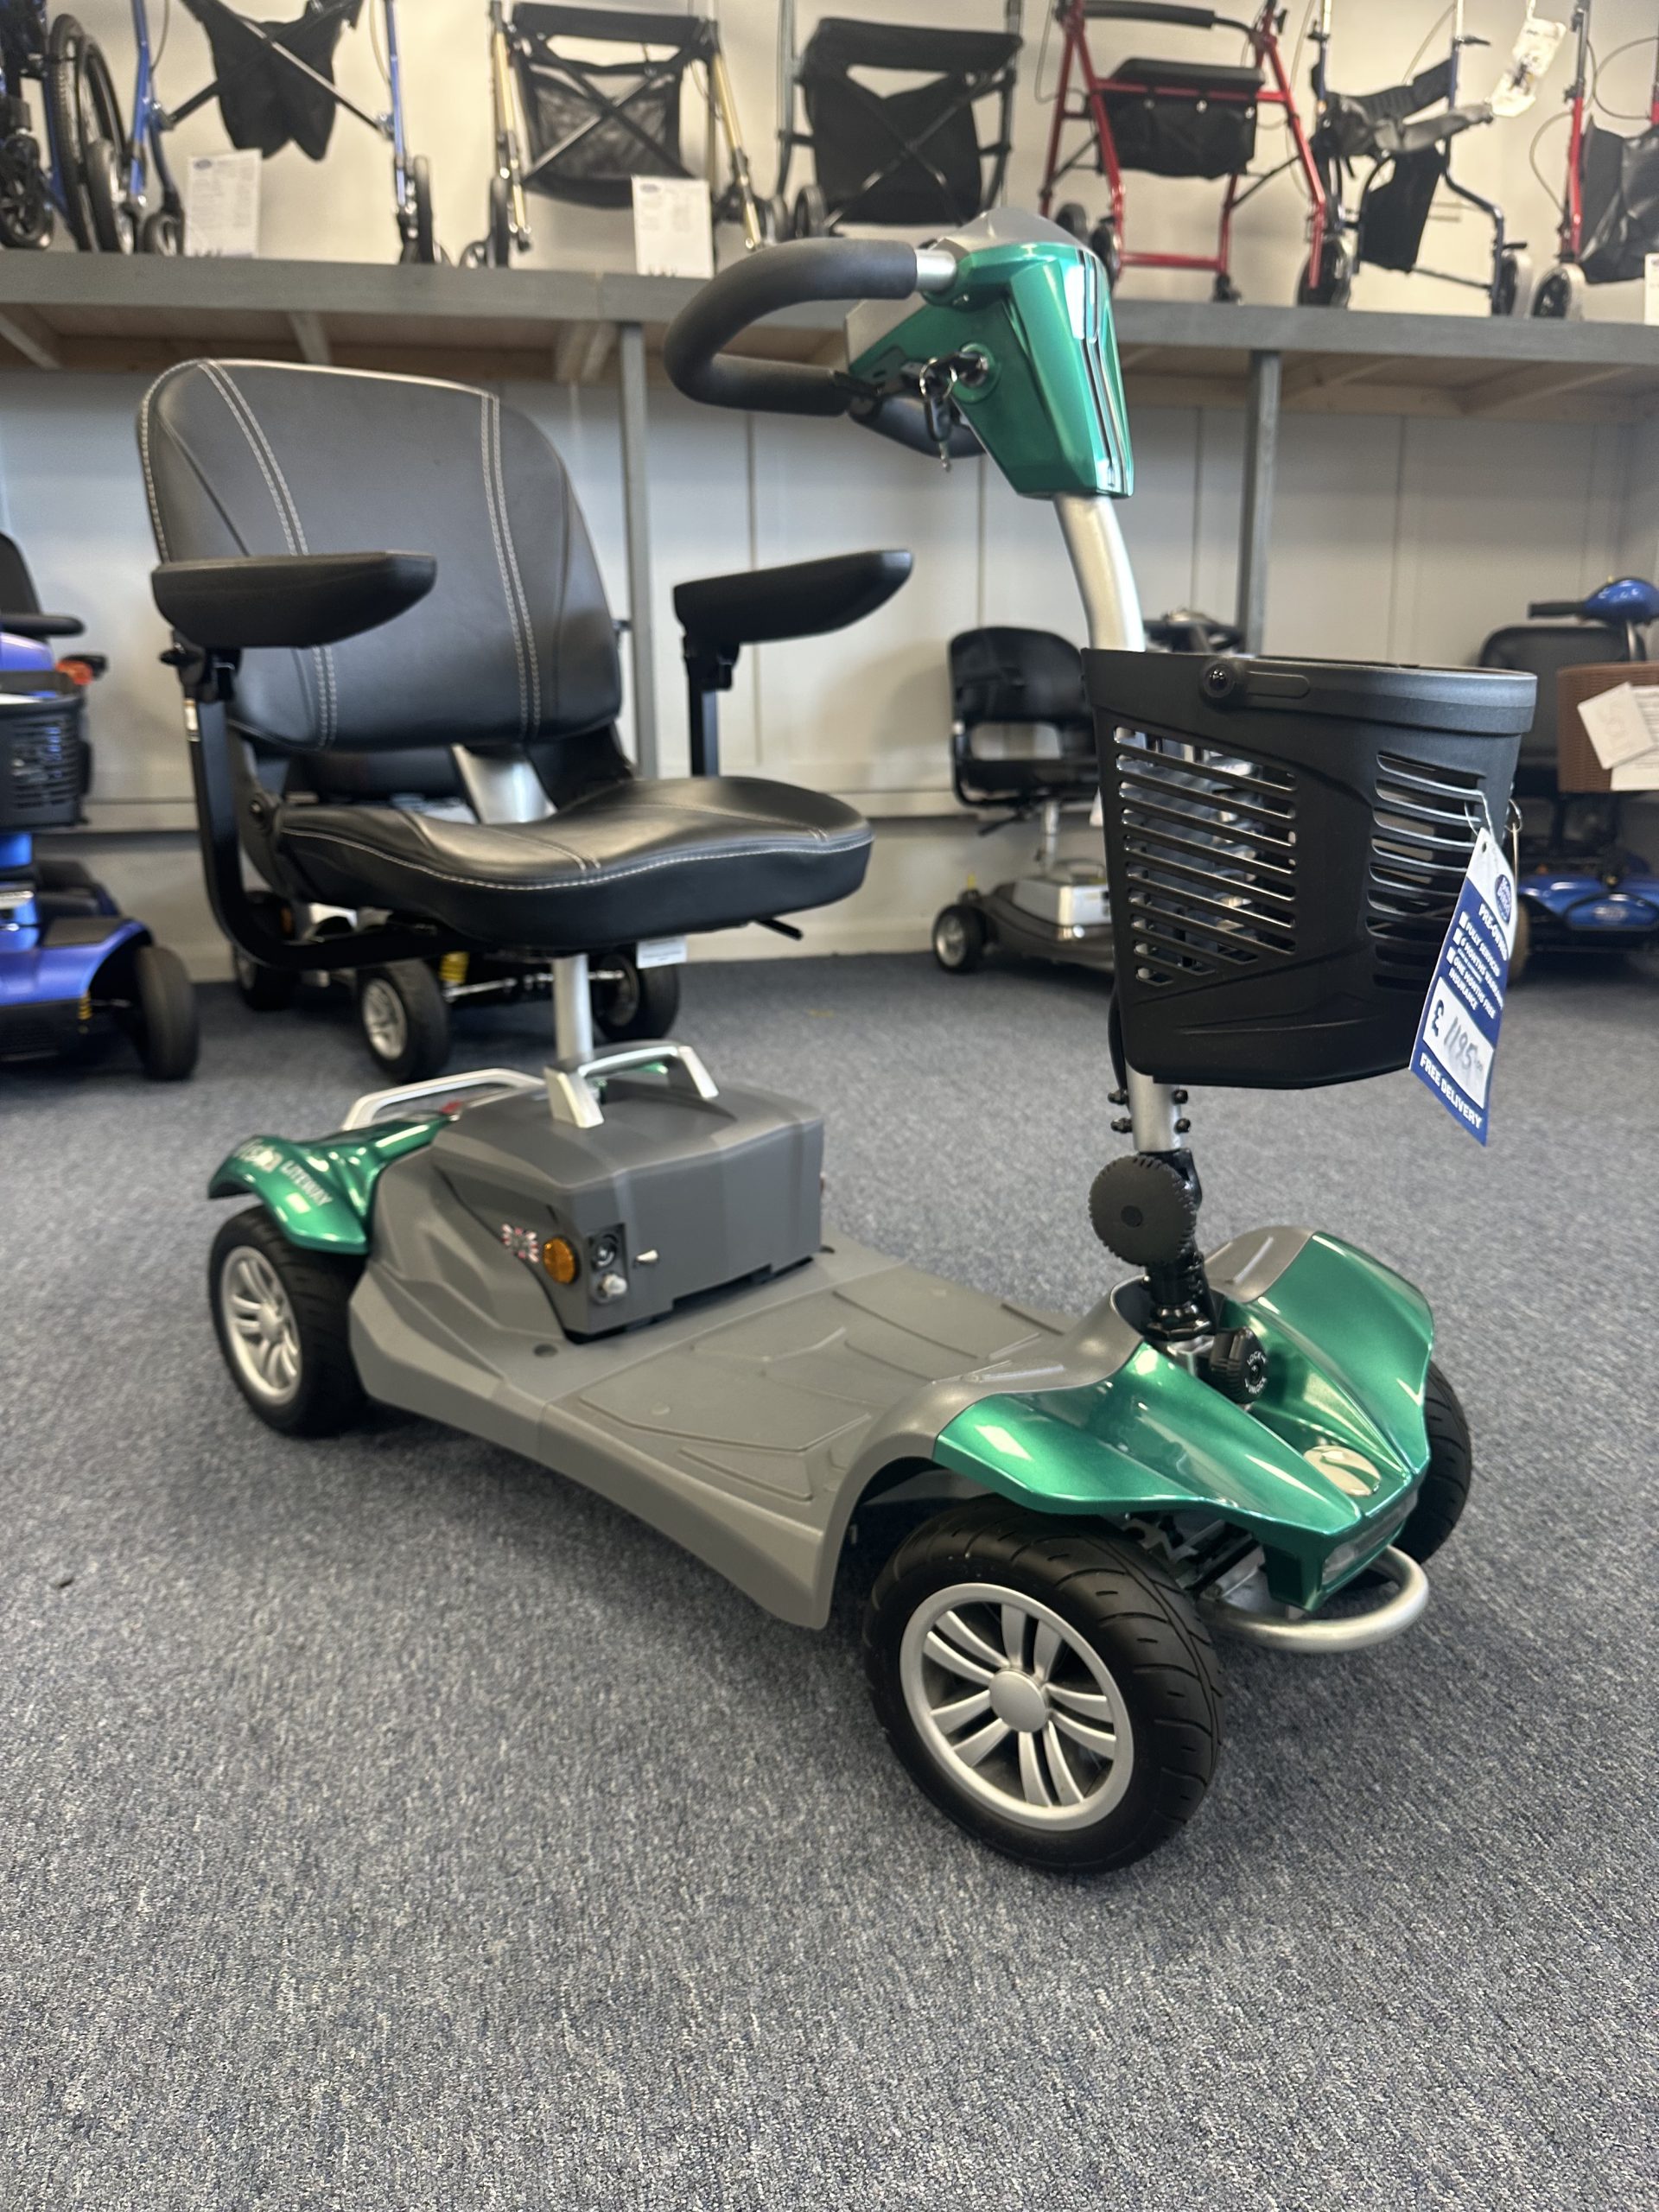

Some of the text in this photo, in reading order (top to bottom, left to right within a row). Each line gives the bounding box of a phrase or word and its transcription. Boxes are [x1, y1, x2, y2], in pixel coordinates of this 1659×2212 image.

[1465, 921, 1482, 946] FULLY
[1460, 937, 1467, 947] 6
[1464, 942, 1486, 976] MONTHS
[1448, 967, 1478, 1011] INSURANCE
[1453, 956, 1466, 976] ONE
[1463, 969, 1486, 1004] MONTHS
[1482, 998, 1497, 1020] FREE
[1431, 999, 1445, 1037] £
[1420, 1052, 1483, 1129] FREE DELIVERY
